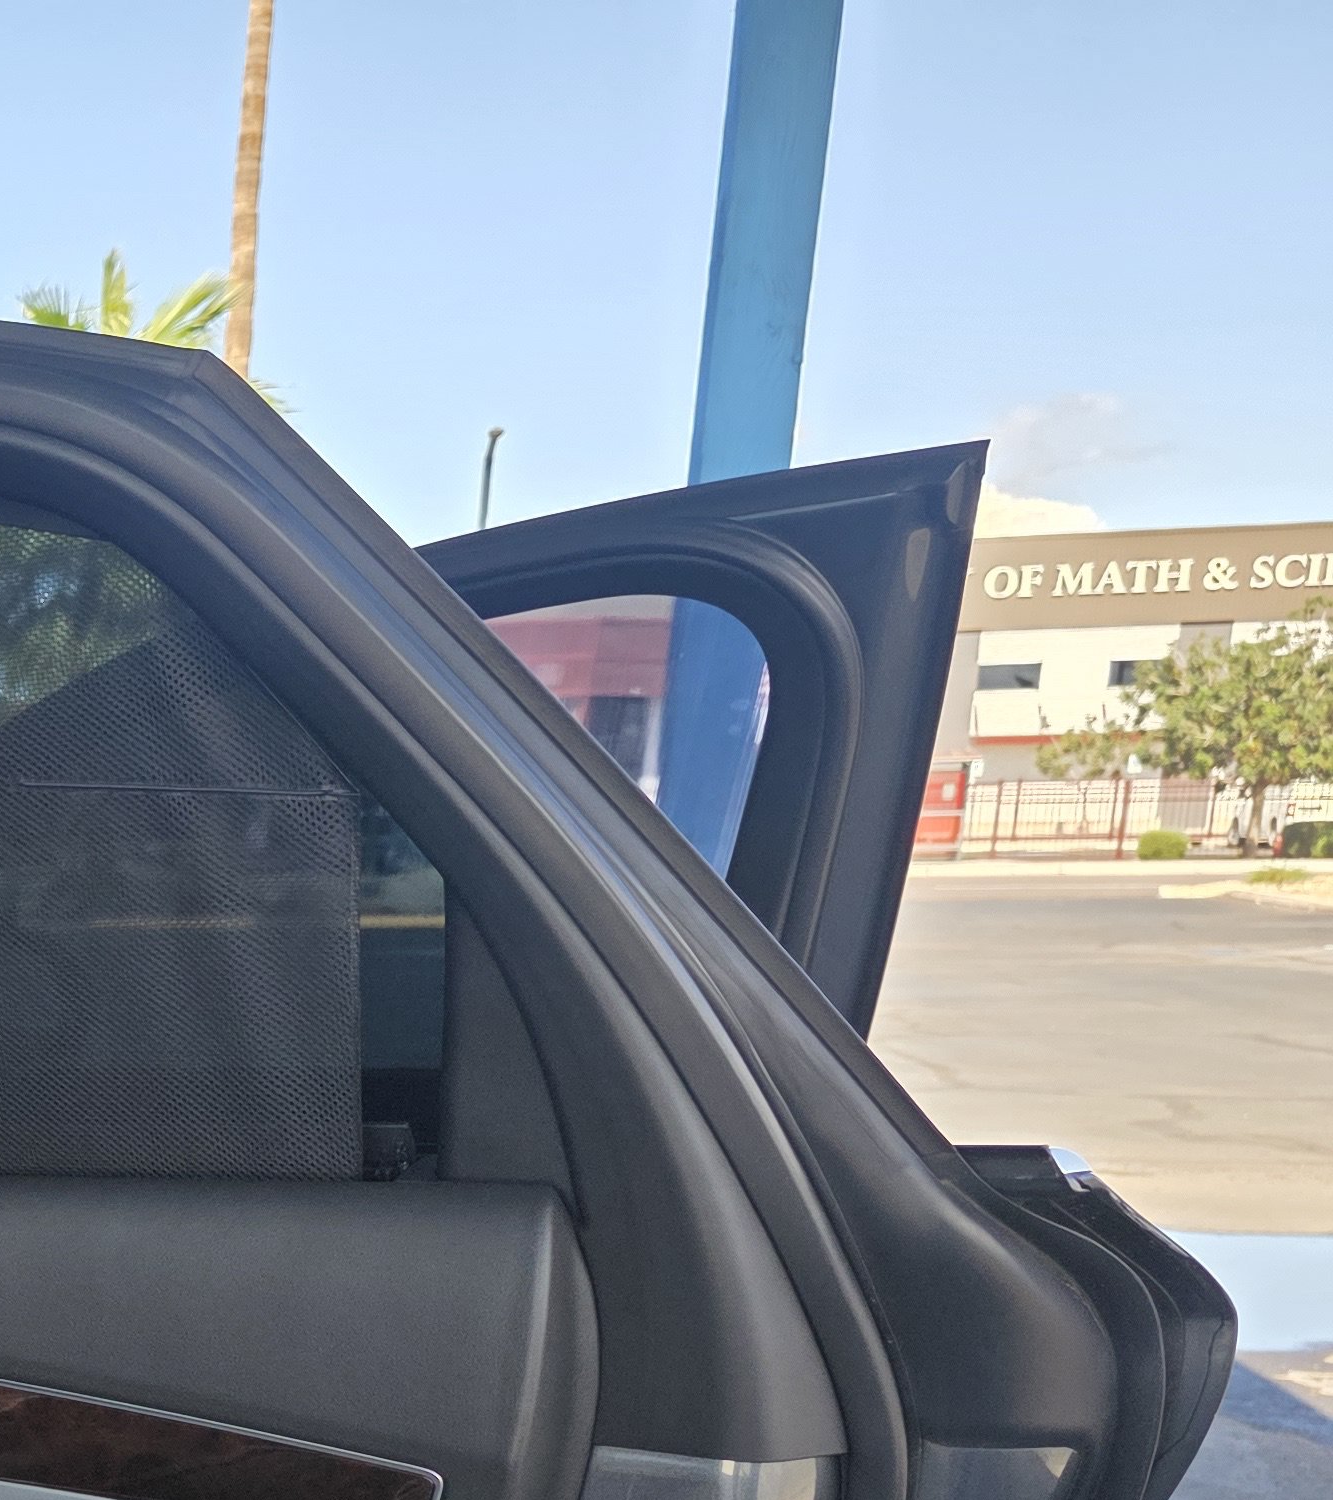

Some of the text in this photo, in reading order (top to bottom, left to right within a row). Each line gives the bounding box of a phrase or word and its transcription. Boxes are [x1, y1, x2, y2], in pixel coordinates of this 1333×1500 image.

[984, 564, 1044, 599] OF
[1052, 559, 1194, 597] MATH
[1203, 557, 1238, 591] &
